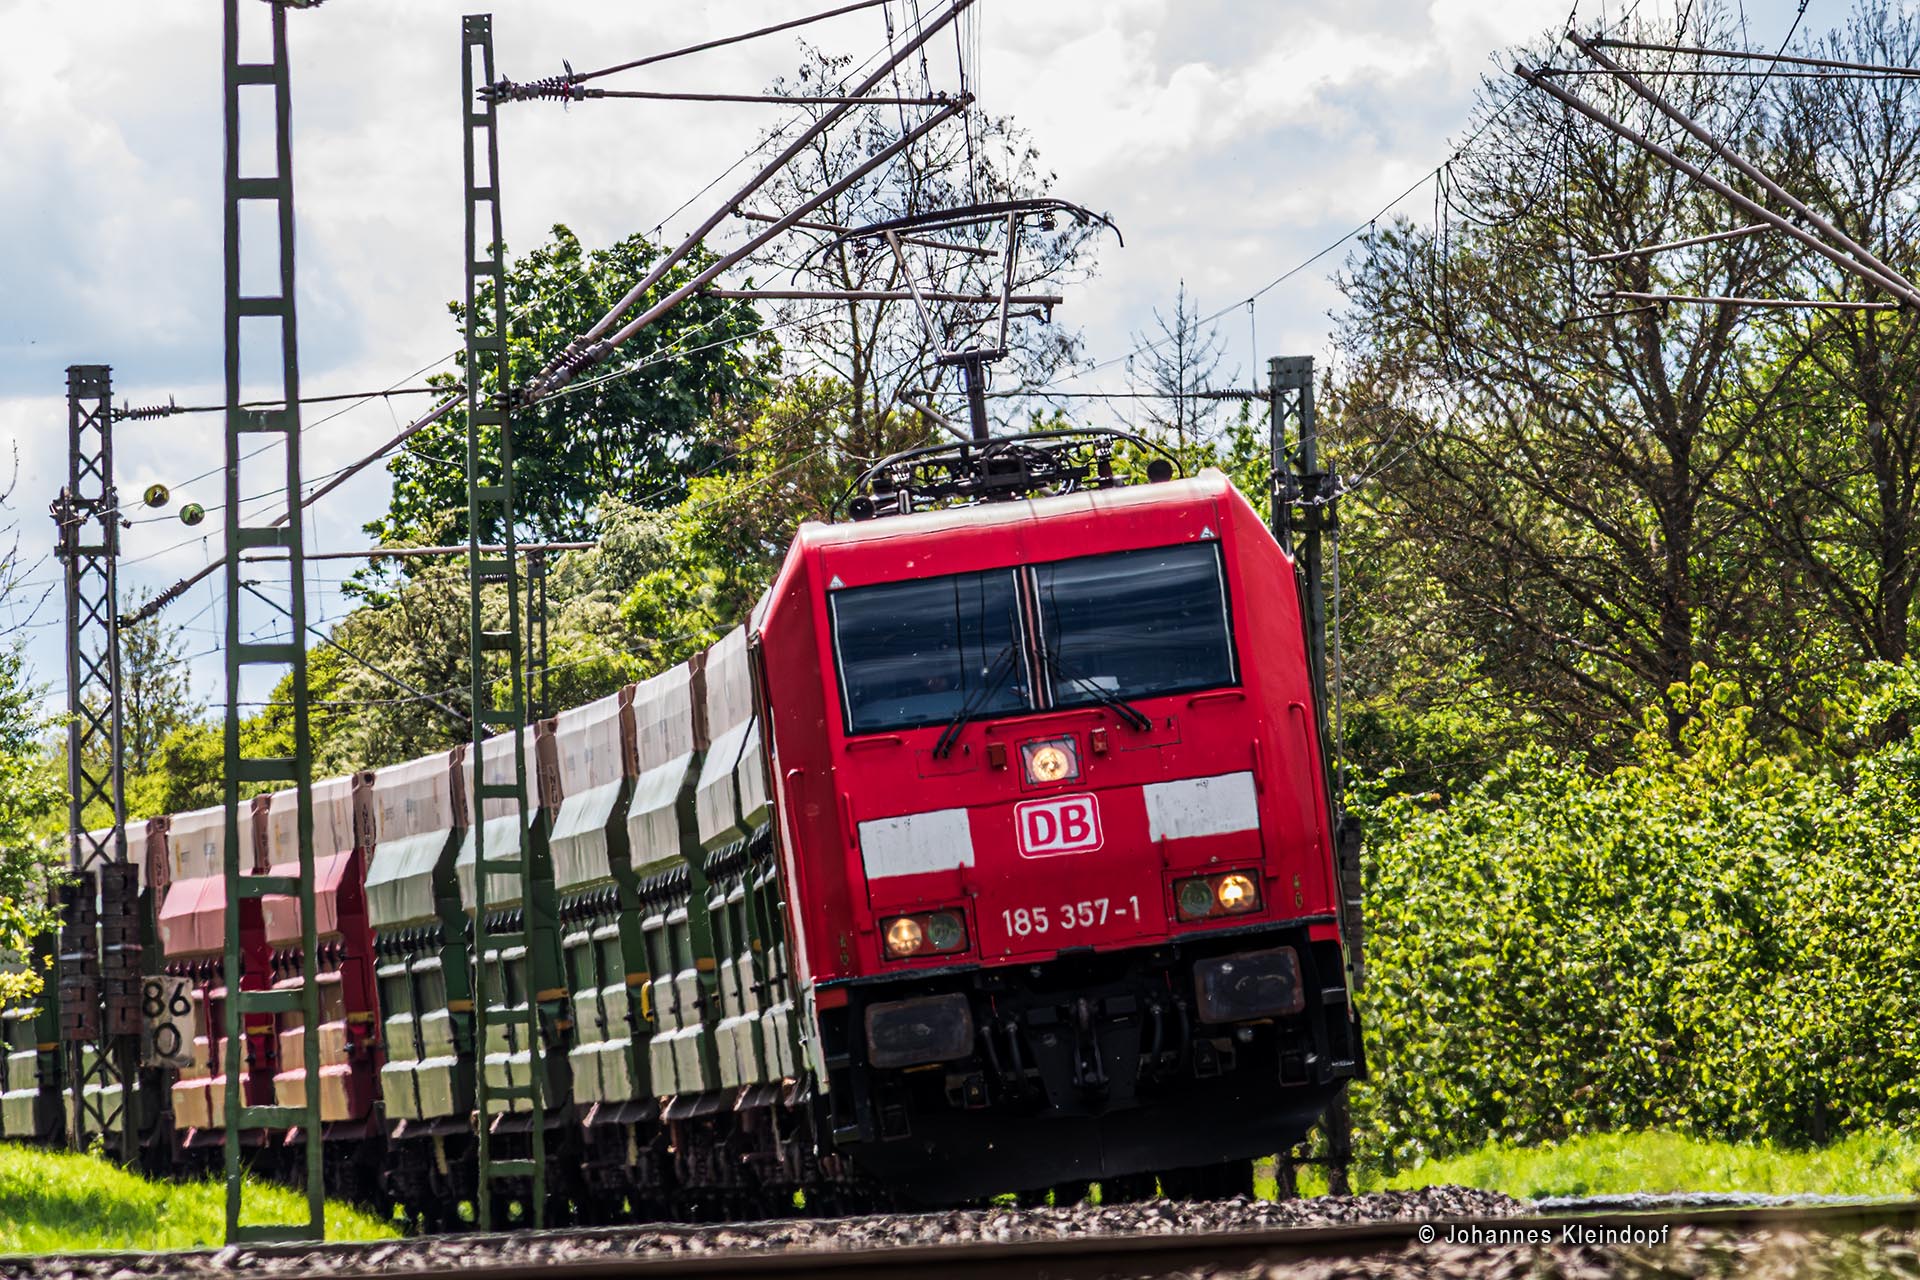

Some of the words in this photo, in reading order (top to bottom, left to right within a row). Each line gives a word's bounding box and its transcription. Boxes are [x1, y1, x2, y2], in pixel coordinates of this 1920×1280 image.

[1028, 804, 1091, 848] DB
[1002, 907, 1049, 937] 185
[1060, 895, 1140, 930] 357-1
[143, 981, 191, 1017] 86
[153, 1022, 181, 1057] 0
